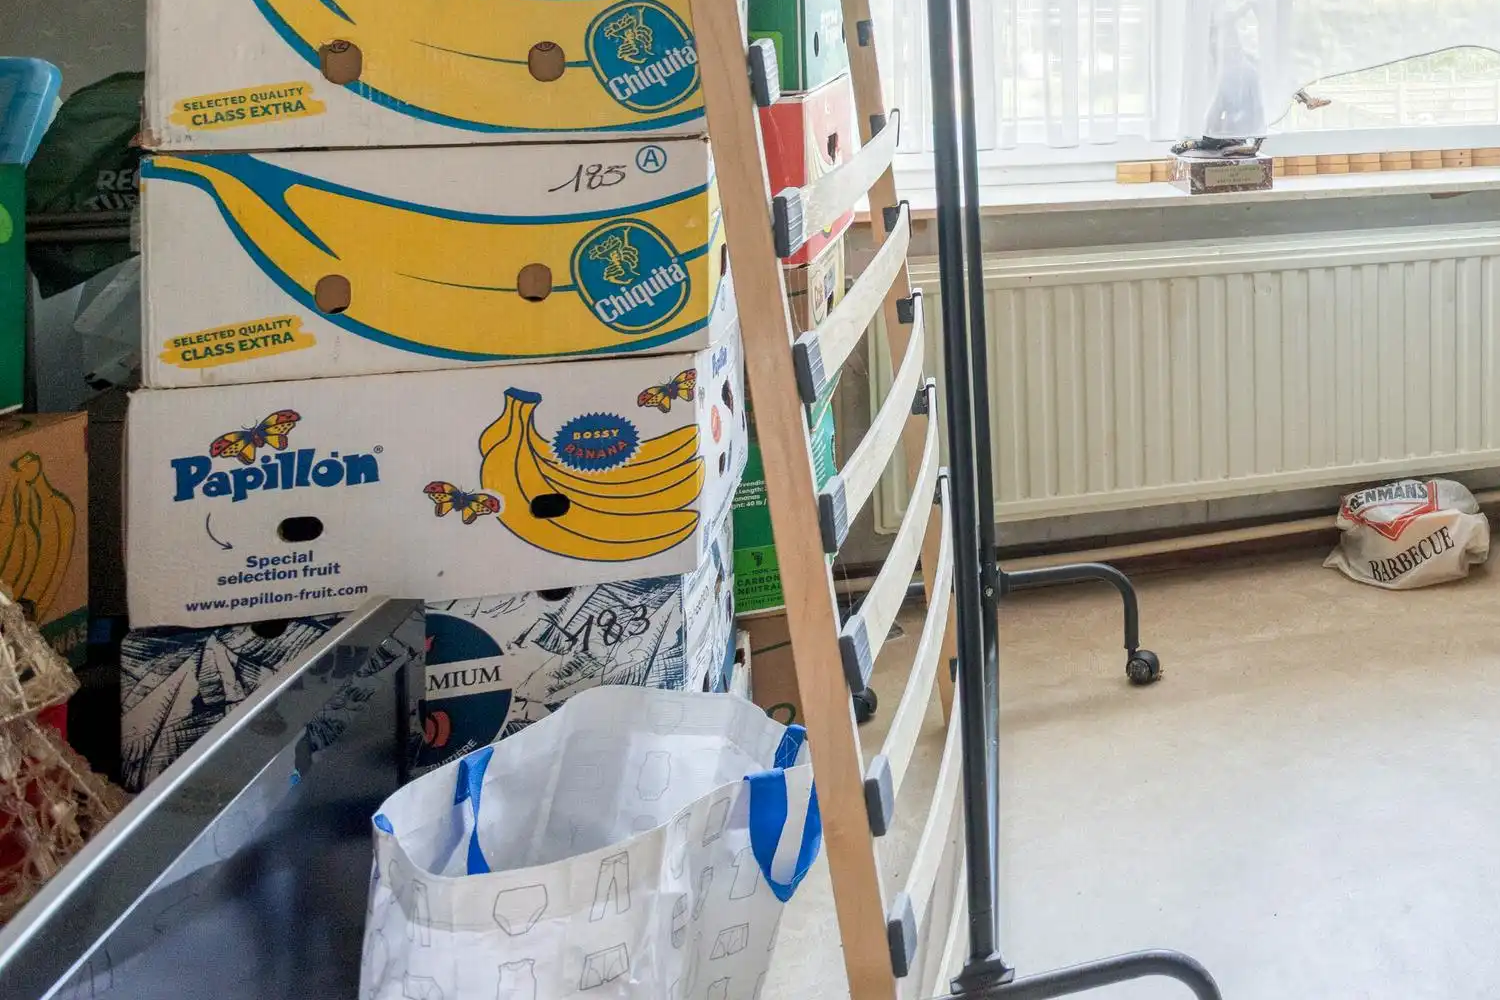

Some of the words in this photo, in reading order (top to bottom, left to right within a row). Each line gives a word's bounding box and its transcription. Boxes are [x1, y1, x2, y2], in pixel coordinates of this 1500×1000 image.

[608, 44, 698, 101] Chiquita
[183, 95, 246, 112] SELECTED
[250, 86, 304, 103] QUALITY
[191, 108, 246, 126] CLASS
[250, 99, 306, 118] EXTRA
[642, 148, 660, 168] A
[548, 163, 628, 193] 185
[594, 261, 687, 324] Chiquita
[173, 329, 236, 348] SELECTED
[238, 318, 293, 336] QUALITY
[181, 342, 235, 362] CLASS
[238, 331, 295, 352] EXTRA
[572, 427, 620, 441] BOSSY
[563, 440, 628, 459] BANANA
[246, 550, 314, 569] Special
[1369, 526, 1454, 582] BARBECUE
[217, 568, 298, 586] selection
[302, 562, 341, 579] fruit
[737, 574, 781, 587] CARBON
[185, 583, 369, 612] www.papillon-fruit.com
[426, 665, 503, 692] MIUM
